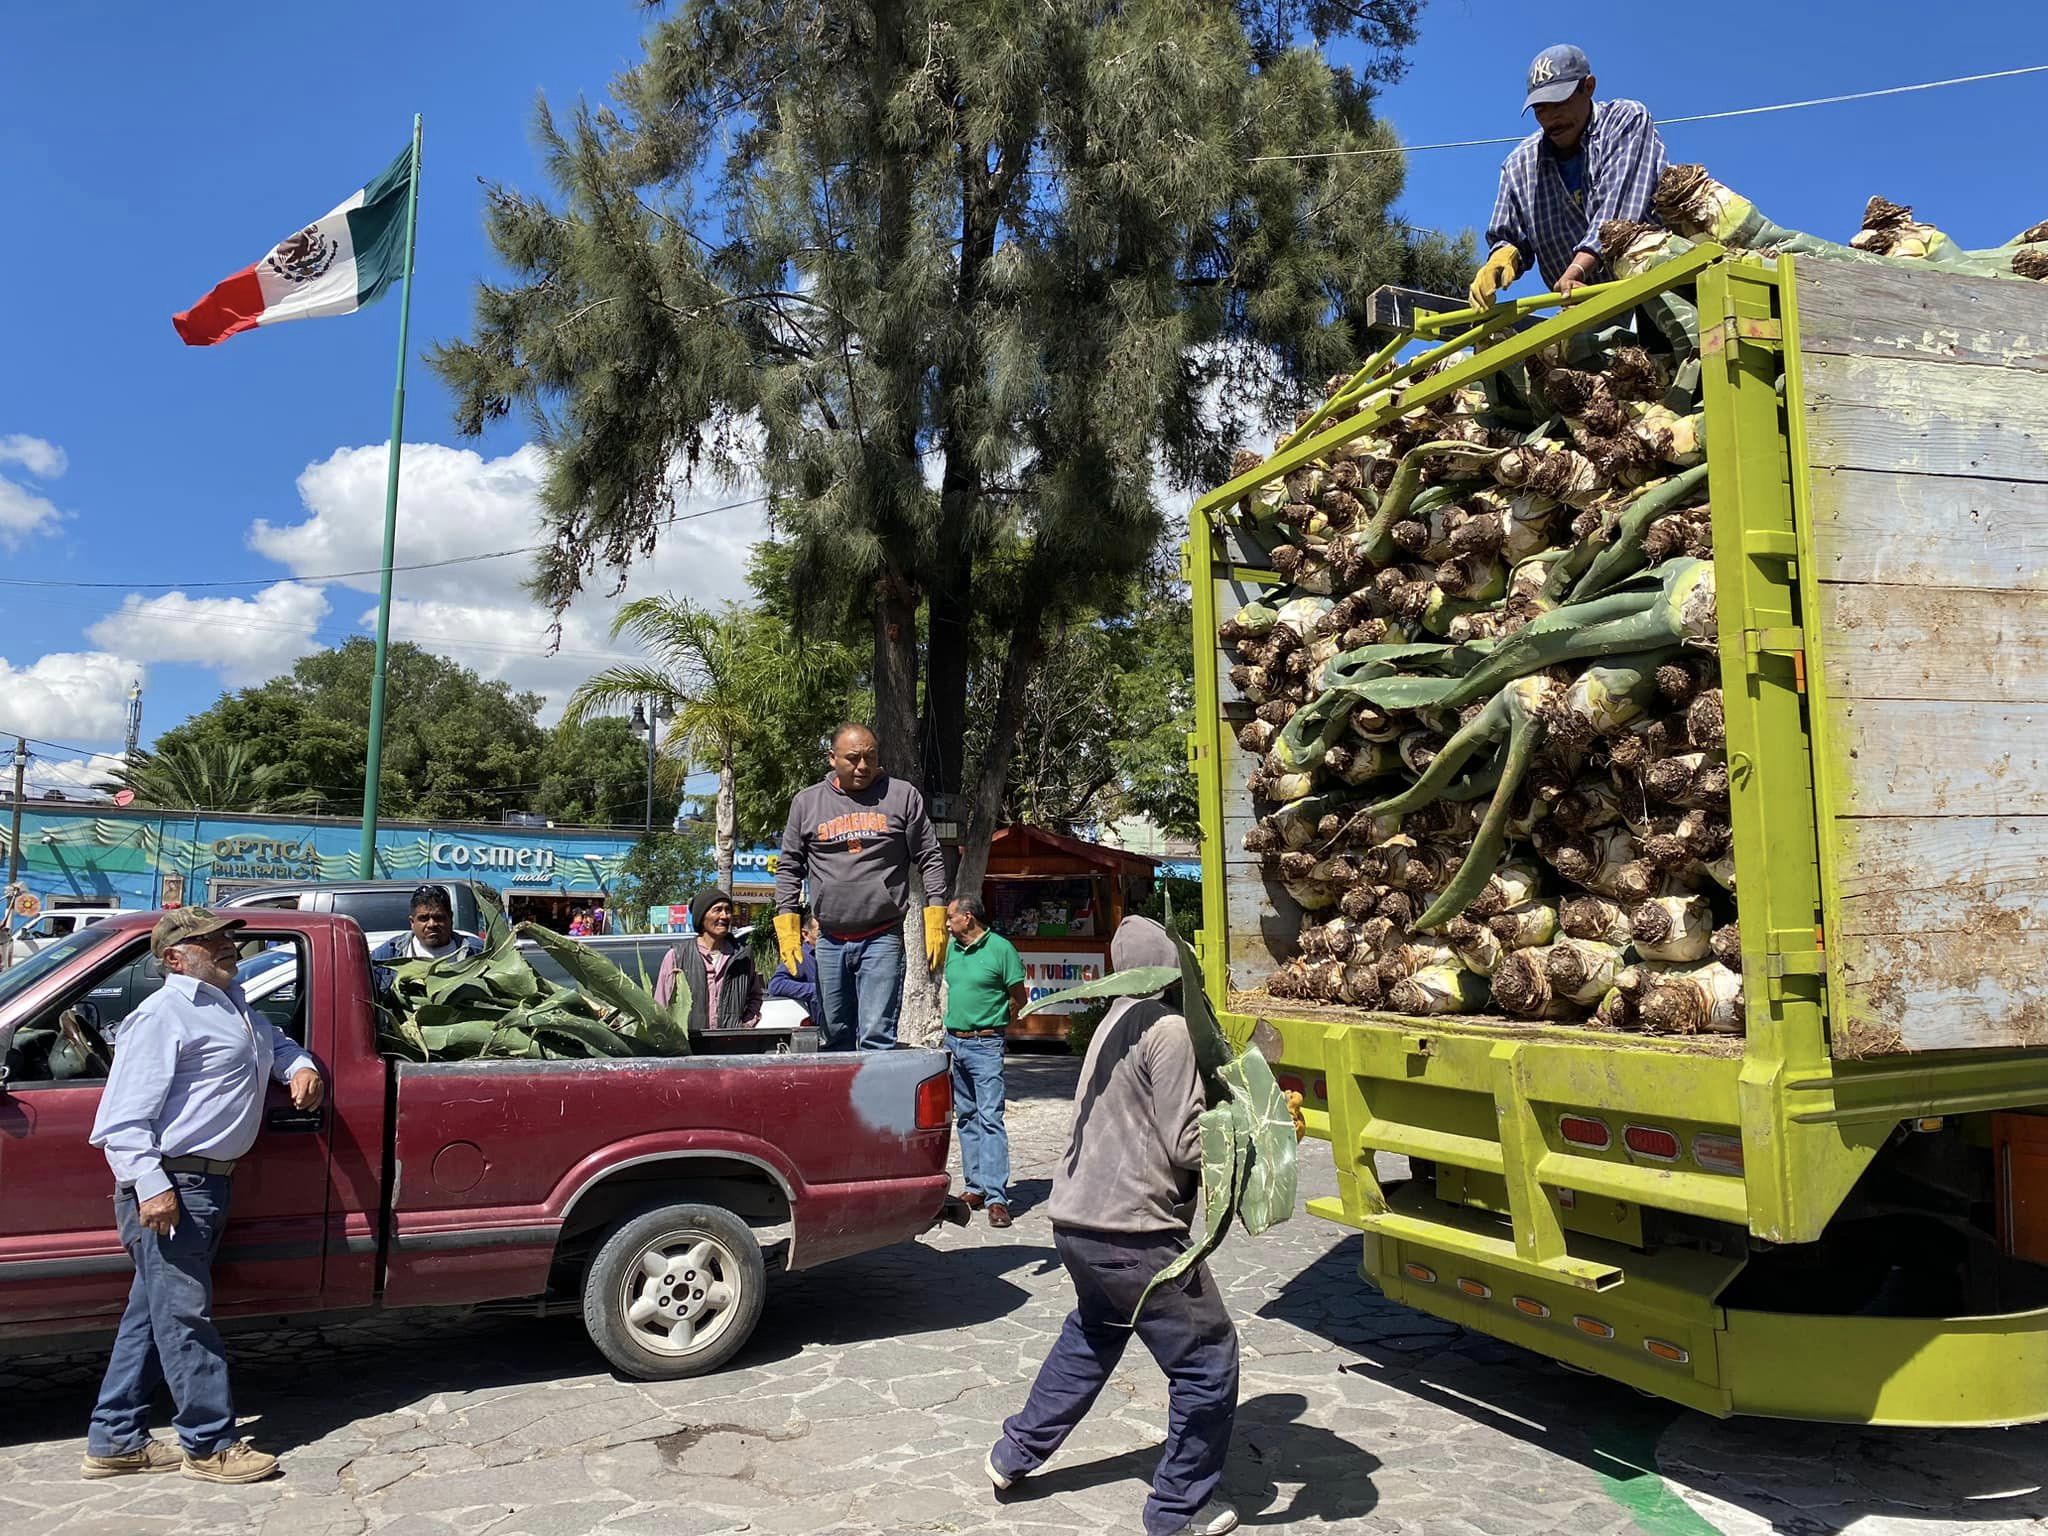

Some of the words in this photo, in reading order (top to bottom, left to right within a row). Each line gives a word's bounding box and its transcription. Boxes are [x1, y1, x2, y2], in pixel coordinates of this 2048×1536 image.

[817, 812, 889, 841] SYRACUSE
[213, 839, 321, 862] OPTICA
[432, 843, 553, 867] Cosmeti
[511, 869, 552, 882] moda
[1040, 959, 1100, 981] TURÍSTICA
